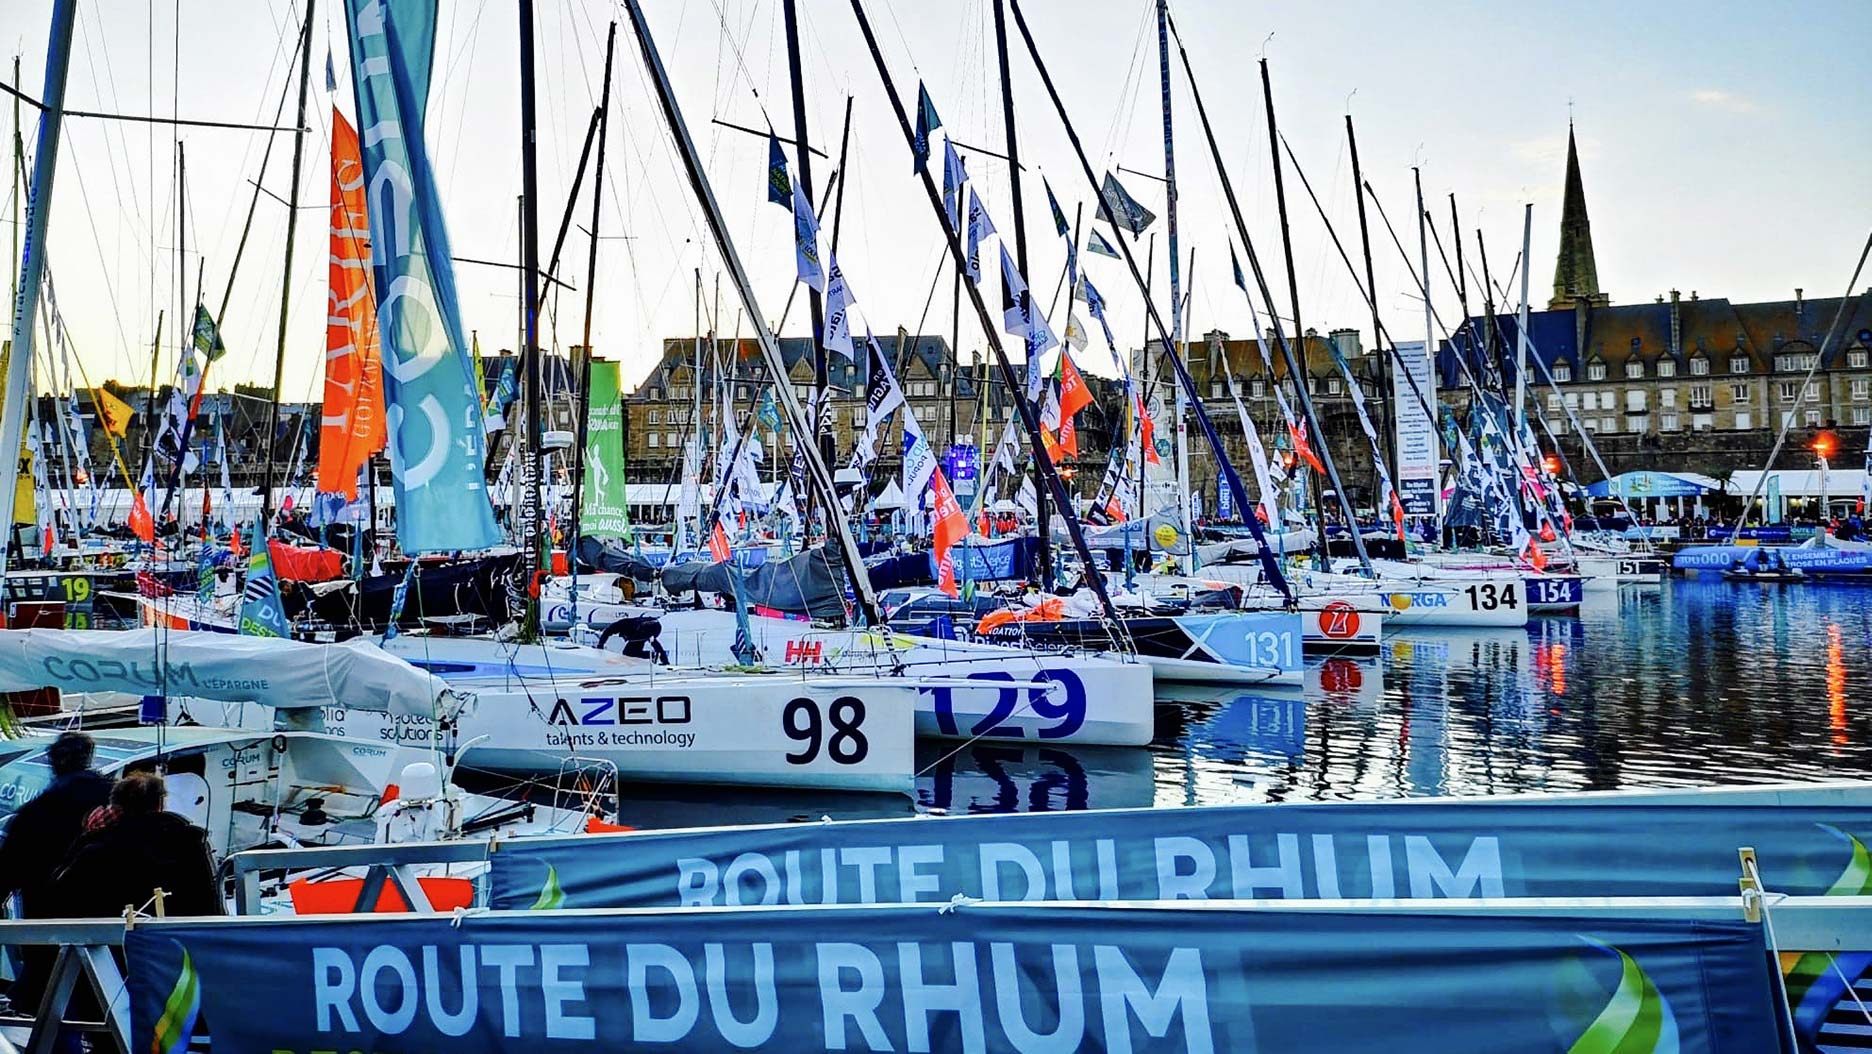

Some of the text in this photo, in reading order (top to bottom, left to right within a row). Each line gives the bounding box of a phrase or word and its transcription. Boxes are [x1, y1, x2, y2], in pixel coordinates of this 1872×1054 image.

[62, 577, 89, 601] 19
[1465, 584, 1517, 611] 134
[1538, 582, 1571, 602] 154
[1245, 631, 1293, 667] 131
[43, 655, 200, 688] CORUM
[548, 695, 692, 726] AZEO
[919, 668, 1087, 738] 129
[547, 731, 696, 748] talents & technology
[782, 696, 869, 765] 98
[677, 832, 1505, 906] ROUTE DU RHUM
[312, 941, 1215, 1054] ROUTE DU RHUM
